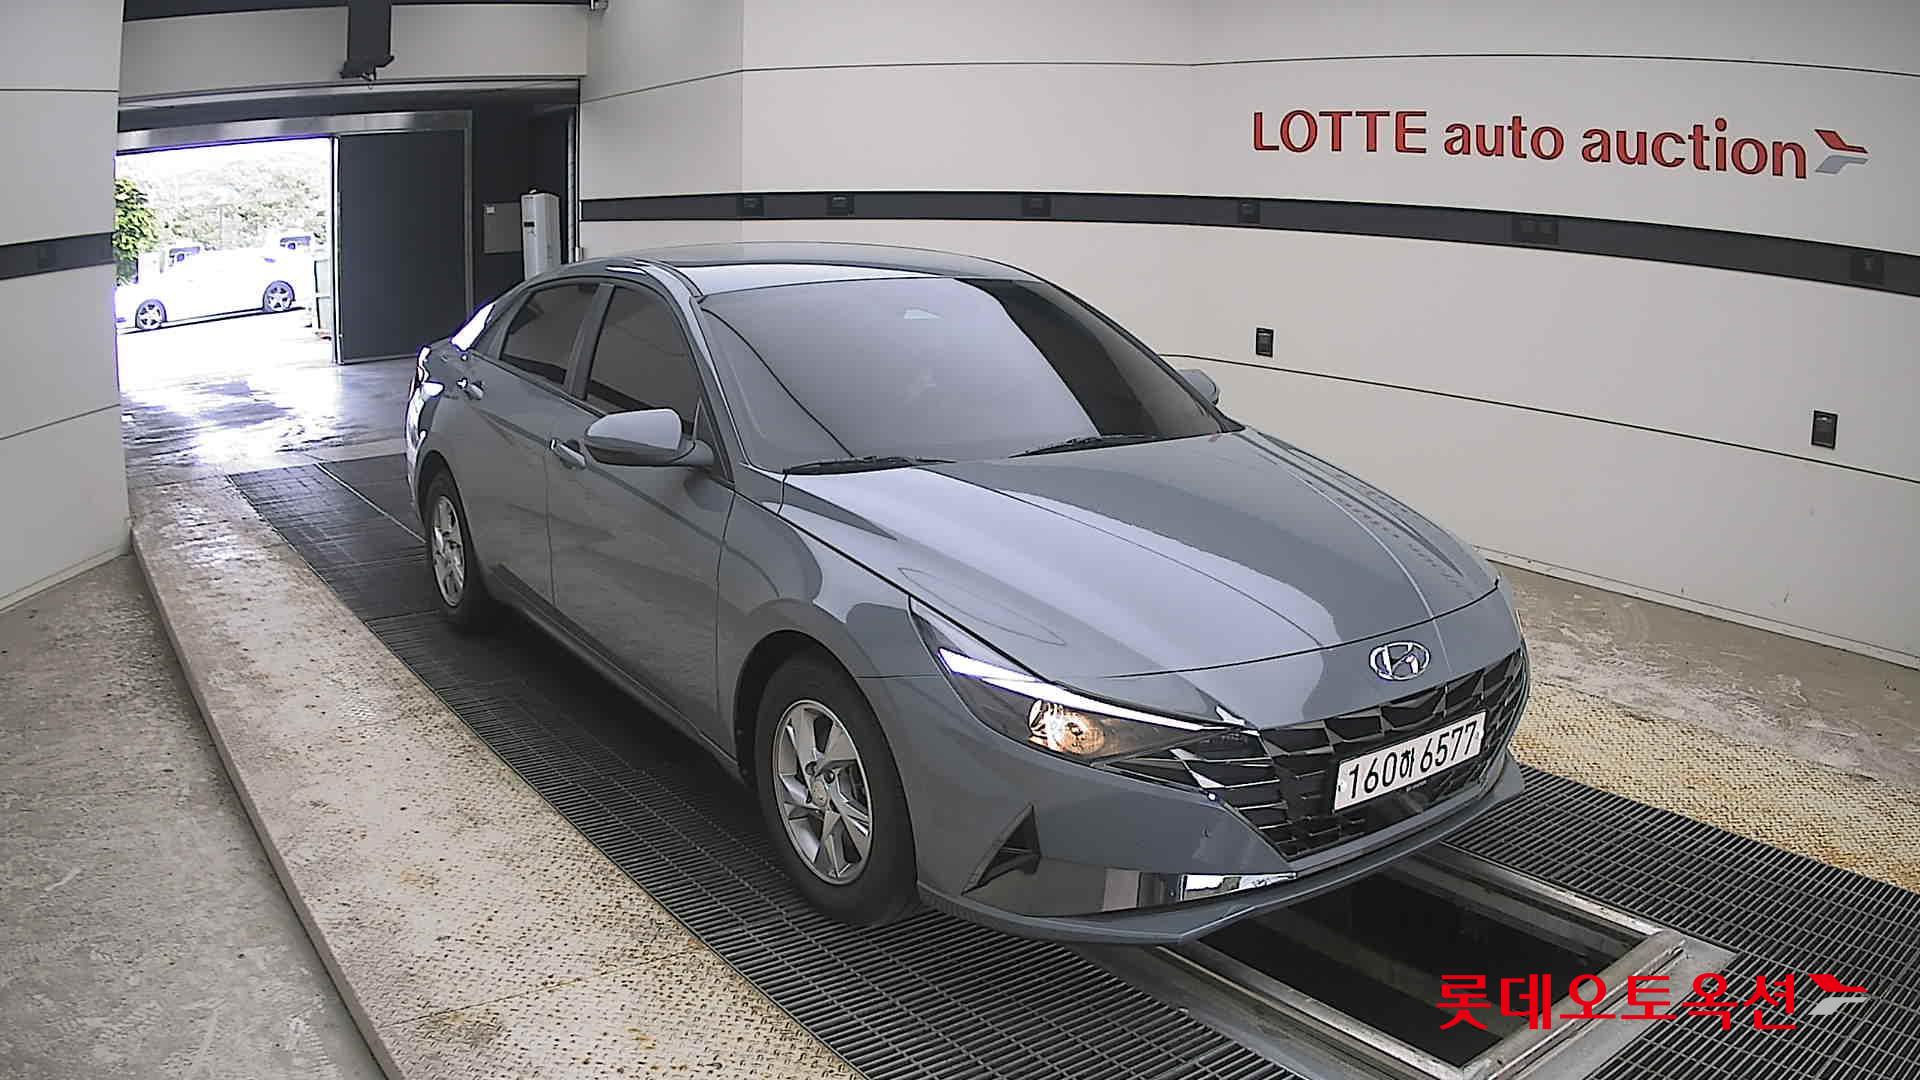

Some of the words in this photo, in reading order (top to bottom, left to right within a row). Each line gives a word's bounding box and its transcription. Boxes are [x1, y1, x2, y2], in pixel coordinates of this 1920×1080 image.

[1253, 110, 1428, 153] LOTTE
[1444, 115, 1565, 162] auto
[1581, 117, 1808, 180] auction
